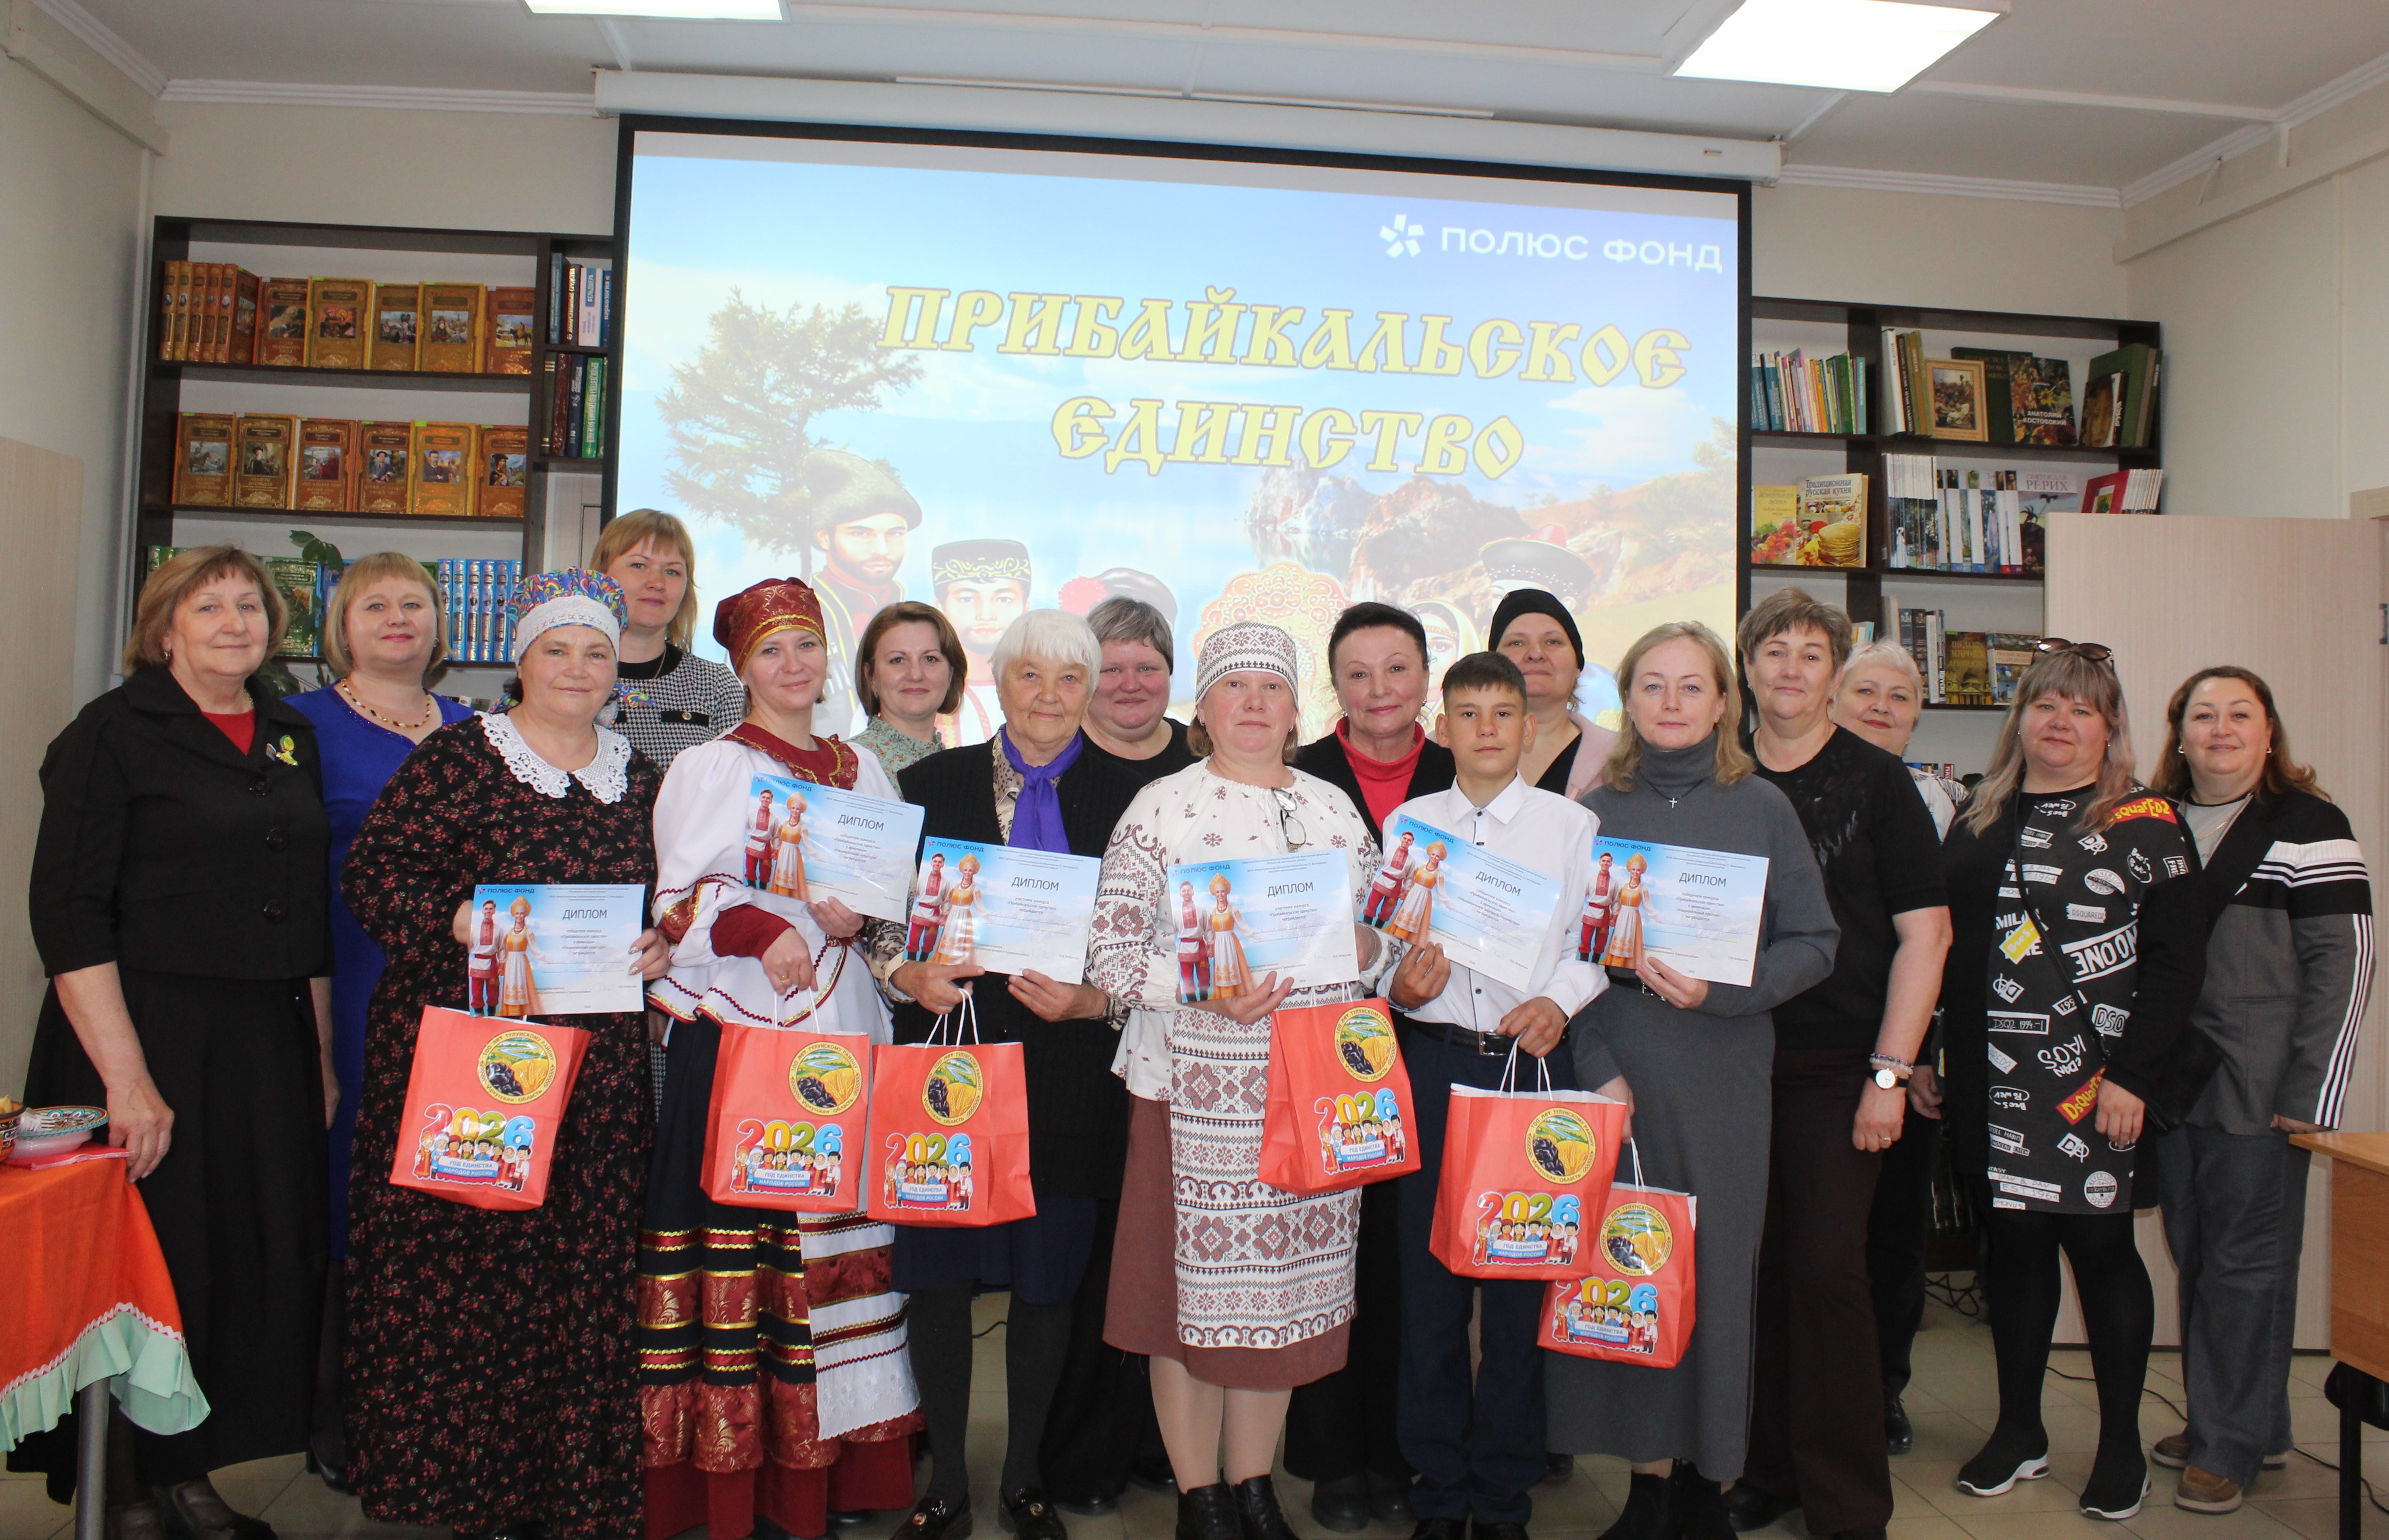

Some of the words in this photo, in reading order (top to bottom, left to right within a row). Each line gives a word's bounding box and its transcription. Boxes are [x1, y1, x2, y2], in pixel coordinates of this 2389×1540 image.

[1441, 227, 1589, 262] ПОЛЮС
[1602, 236, 1723, 274] ФОНД
[876, 285, 1693, 390] ПРИБАЙКАЛЬСКОЕ
[1051, 394, 1524, 481] ЕДИНСТВО
[1806, 479, 1852, 488] Традиционная
[2026, 480, 2069, 491] РЕРИХ
[765, 778, 790, 787] ПОЛЮС
[792, 783, 812, 792] ФОНД
[837, 814, 885, 831] ДИПЛОМ
[1408, 820, 1433, 836] ПОЛЮС
[1434, 831, 1455, 844] ФОНД
[1604, 841, 1629, 849] ПОЛЮС
[1180, 866, 1207, 875] ПОЛЮС
[1011, 877, 1060, 891] ДИПЛОМ
[1475, 870, 1522, 897] ДИПЛОМ
[1678, 872, 1727, 887] ДИПЛОМ
[1268, 882, 1314, 899] ДИПЛОМ
[562, 909, 607, 920] ДИПЛОМ
[2072, 909, 2104, 919] DSQUARED2
[1350, 1008, 1381, 1019] ТУЛУНСКОМУ
[1380, 1016, 1394, 1038] РАЙОНУ
[483, 1045, 492, 1056] 100
[505, 1032, 542, 1042] ТУЛУНСКОМУ
[541, 1040, 555, 1061] РАЙОНУ
[791, 1060, 799, 1072] 100
[808, 1043, 842, 1053] ТУЛУНСКОМУ
[842, 1050, 858, 1069] РАЙОНУ
[934, 1060, 943, 1069] 100
[956, 1052, 978, 1069] ТУЛУНСКОМУ
[1345, 1063, 1368, 1080] Иркутская
[486, 1084, 515, 1102] Иркутская
[801, 1099, 829, 1114] Иркутская
[923, 1097, 941, 1122] Иркутская
[1314, 1088, 1398, 1127] 2026
[421, 1103, 535, 1148] 2026
[1531, 1118, 1540, 1129] 100
[1553, 1109, 1585, 1124] ТУЛУНСКОМУ
[1583, 1124, 1594, 1147] РАЙОНУ
[736, 1119, 843, 1154] 2026
[886, 1133, 971, 1166] 2026
[1359, 1143, 1381, 1152] ЕДИНСТВА
[443, 1168, 470, 1176] НАРОДОВ
[1531, 1159, 1556, 1181] Иркутская
[1477, 1192, 1580, 1224] 2026
[1622, 1205, 1657, 1214] ТУЛУНСКОМУ
[1657, 1212, 1670, 1233] РАЙОНУ
[1609, 1259, 1637, 1274] Иркутская
[1555, 1277, 1658, 1313] 2026
[1580, 1331, 1604, 1340] НАРОДОВ
[1597, 1326, 1623, 1335] ЕДИНСТВА
